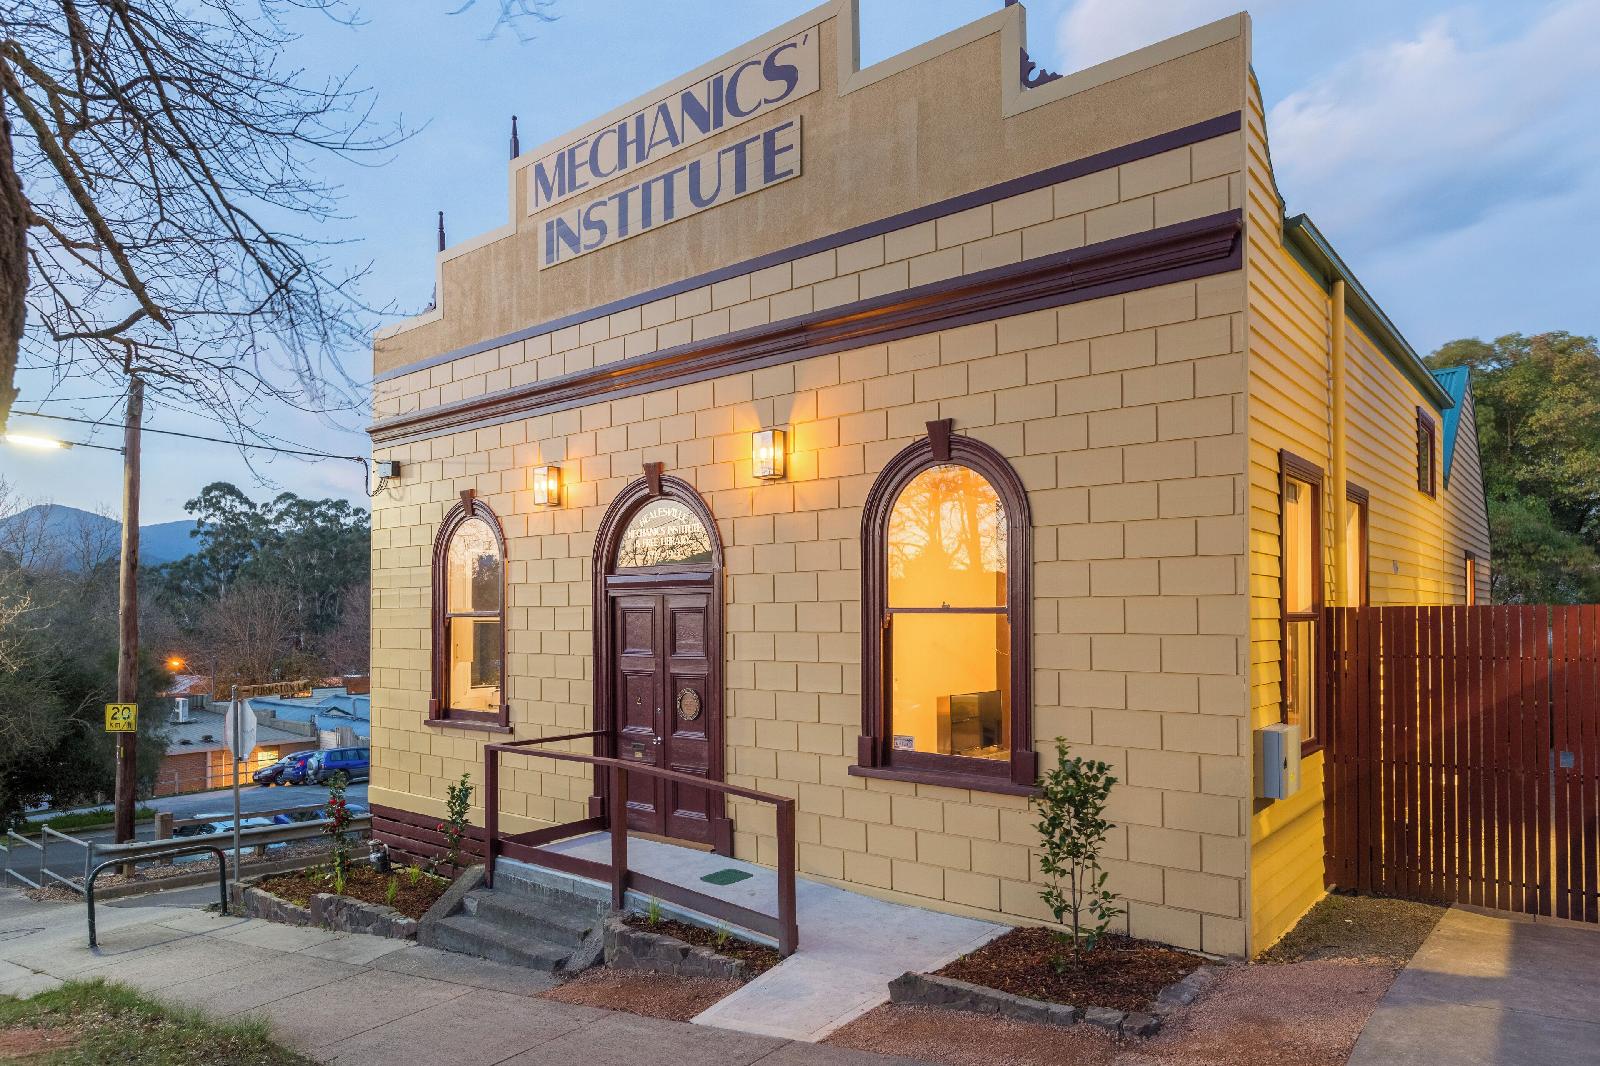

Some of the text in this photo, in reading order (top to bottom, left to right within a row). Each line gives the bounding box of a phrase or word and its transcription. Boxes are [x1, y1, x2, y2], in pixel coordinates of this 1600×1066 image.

[545, 121, 794, 265] INSTITUTE
[639, 508, 687, 527] HEALESVILLE
[667, 523, 701, 535] INSTITUTE
[643, 538, 659, 548] FREE
[660, 535, 690, 546] LIBRARY
[111, 706, 131, 720] 20
